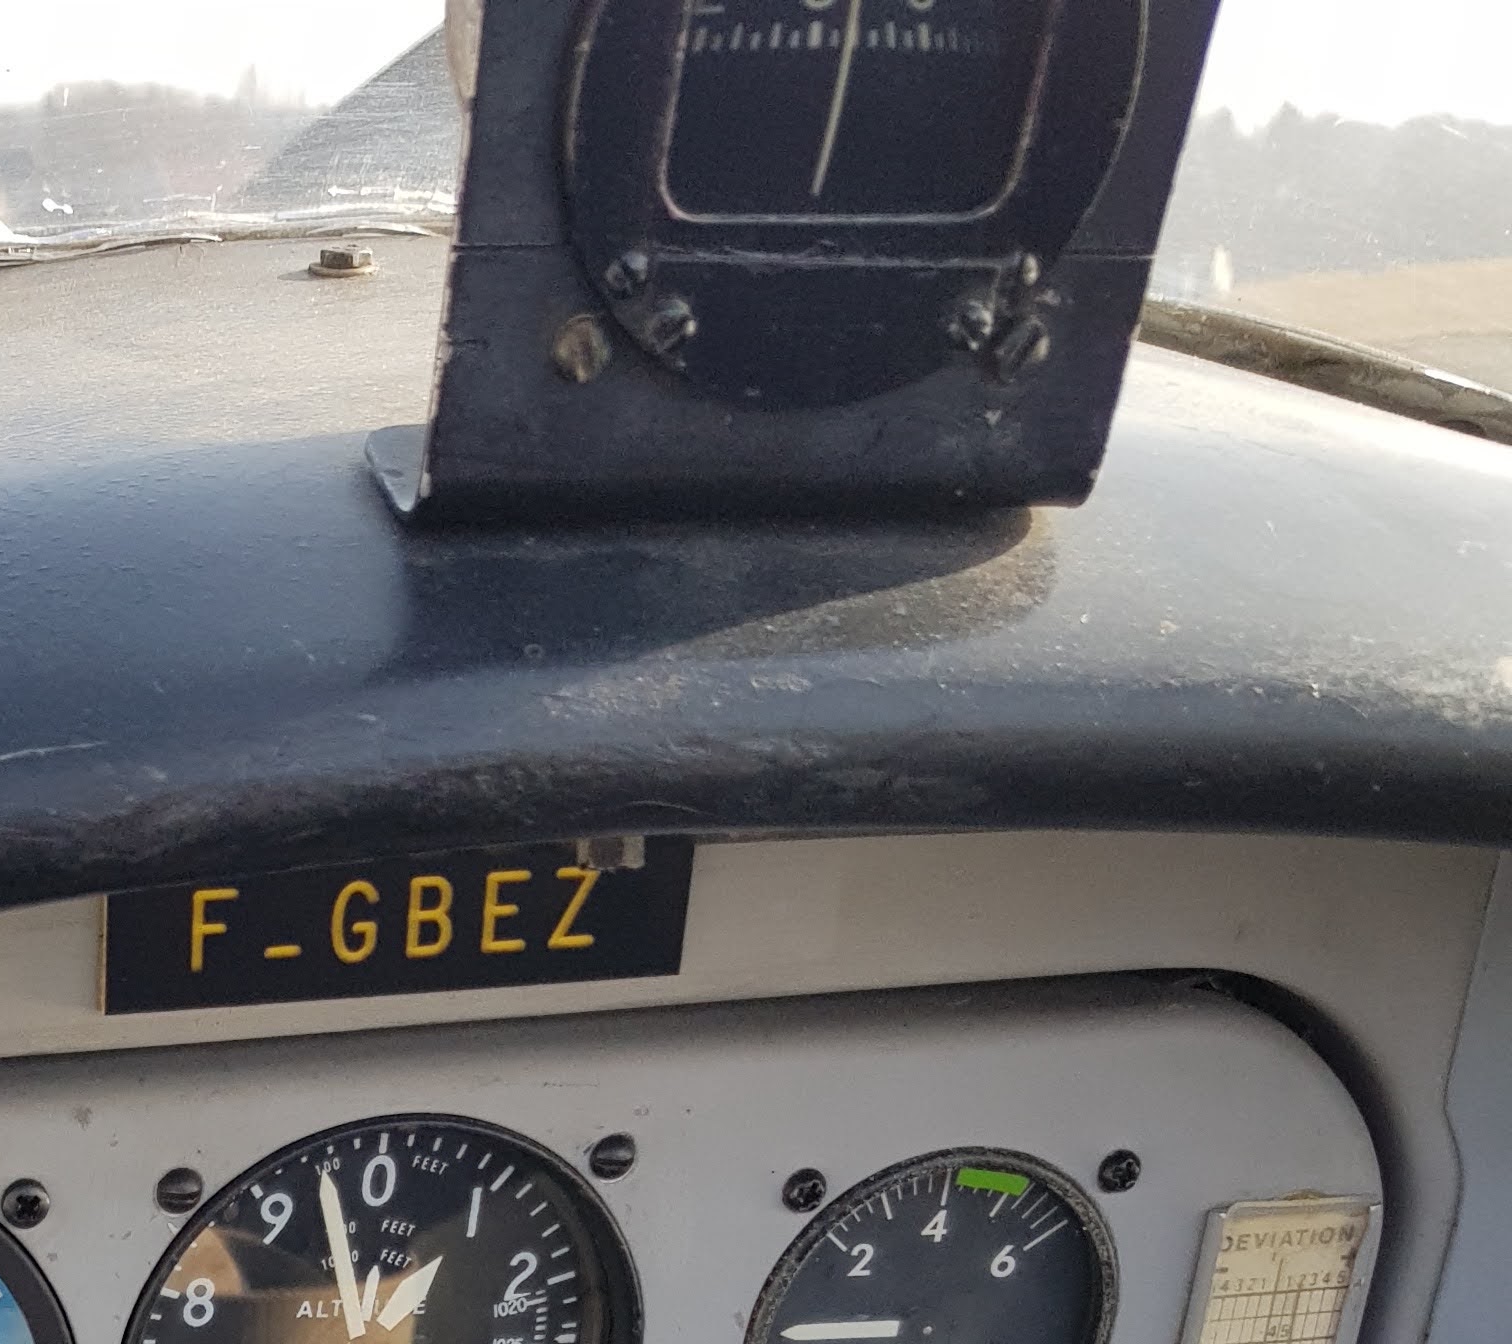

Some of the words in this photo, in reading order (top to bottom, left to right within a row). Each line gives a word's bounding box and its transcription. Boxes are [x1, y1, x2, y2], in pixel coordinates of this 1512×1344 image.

[361, 1155, 397, 1207] 0
[412, 1155, 448, 1175] FEET
[260, 1192, 294, 1245] 9
[381, 1218, 416, 1238] FEET
[466, 1187, 482, 1238] 1
[920, 1209, 948, 1243] 4
[1221, 1223, 1355, 1252] DEVIATION
[380, 1248, 412, 1269] FEET
[847, 1243, 874, 1277] 2
[990, 1244, 1016, 1278] 6
[503, 1251, 538, 1302] 2
[183, 1278, 215, 1327] 8
[493, 1298, 528, 1318] 1020
[1267, 1324, 1291, 1337] 45
